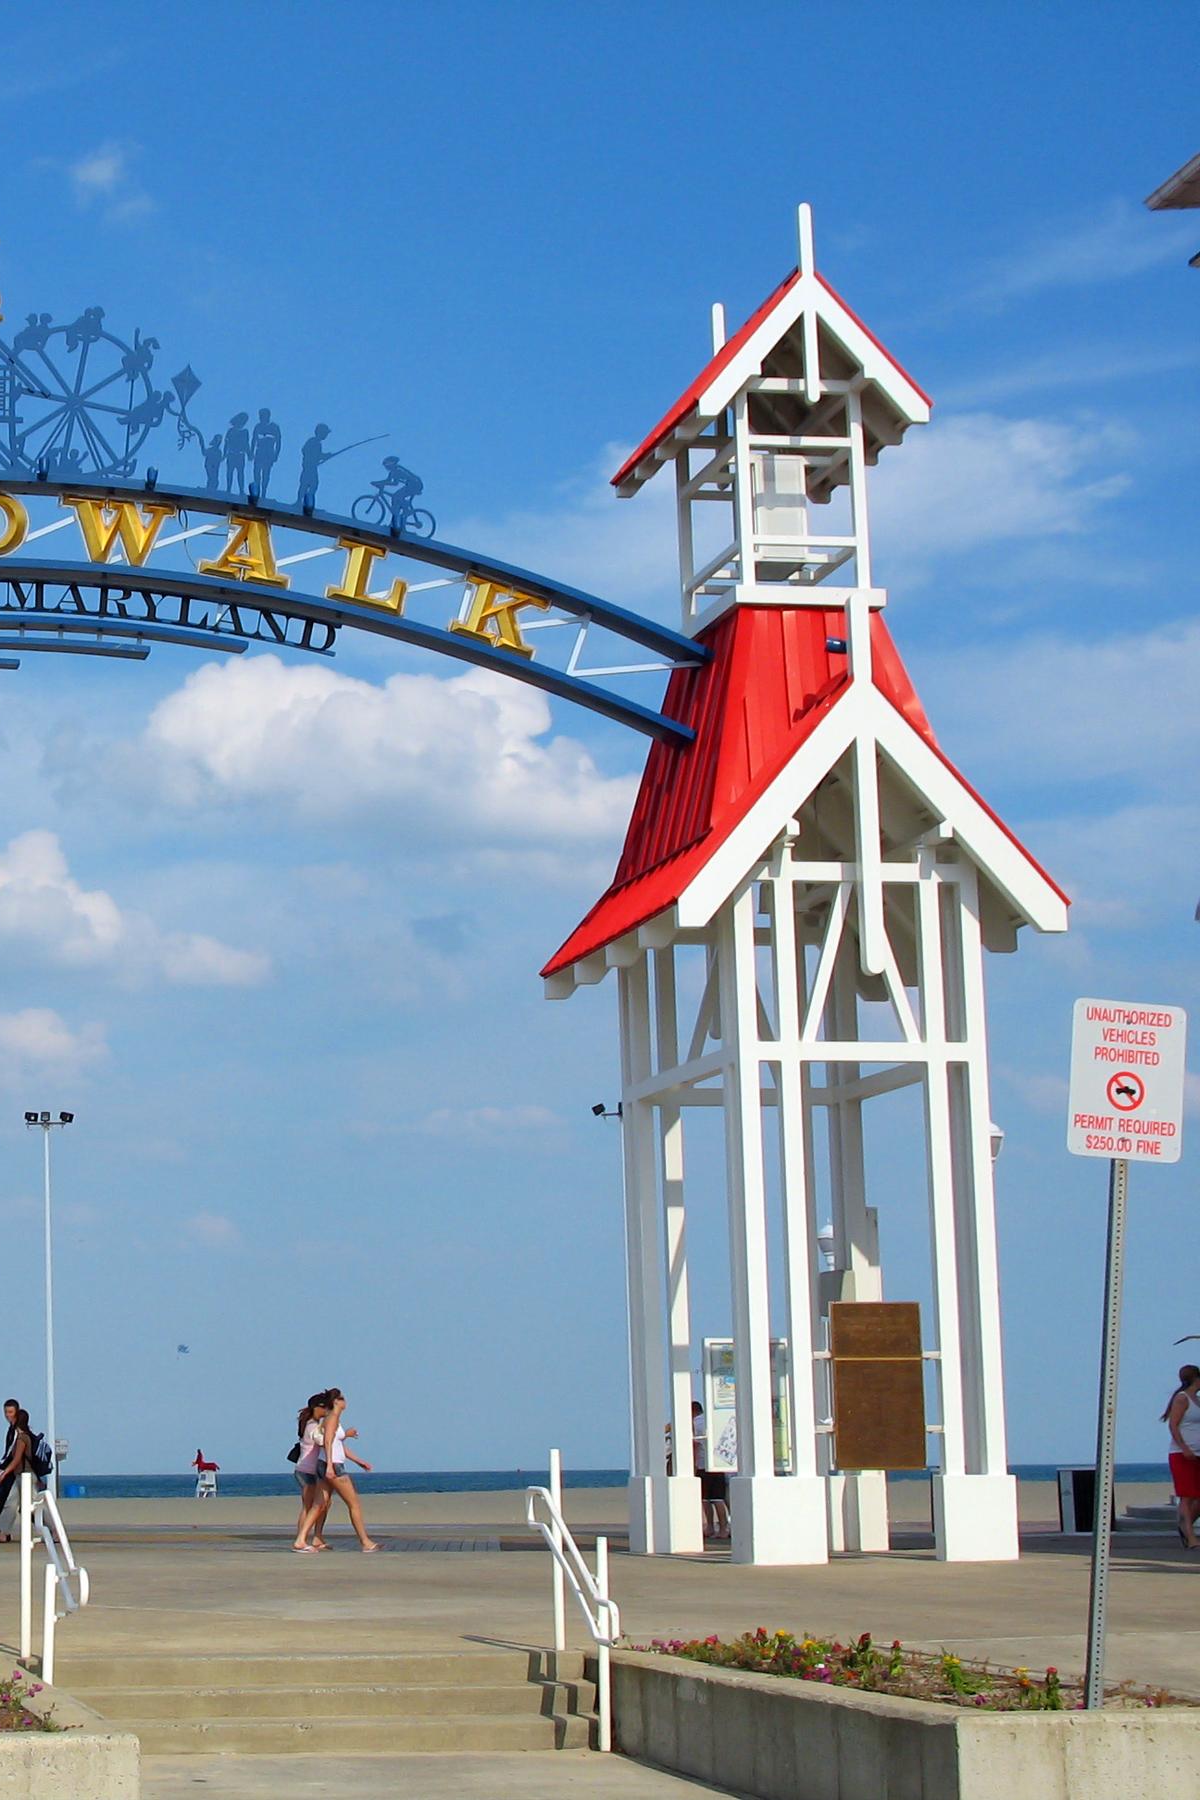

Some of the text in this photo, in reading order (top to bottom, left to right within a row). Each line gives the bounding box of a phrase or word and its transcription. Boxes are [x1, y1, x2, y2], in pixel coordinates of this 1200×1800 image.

[3, 579, 337, 652] MARYLAND
[1086, 1006, 1172, 1027] UNAUTHORIZED
[1102, 1028, 1156, 1046] VEHICLES
[1094, 1046, 1160, 1066] PROHIBITED
[1073, 1113, 1176, 1137] PERMIT REQUIRED
[1085, 1134, 1162, 1156] $250.00 FINE
